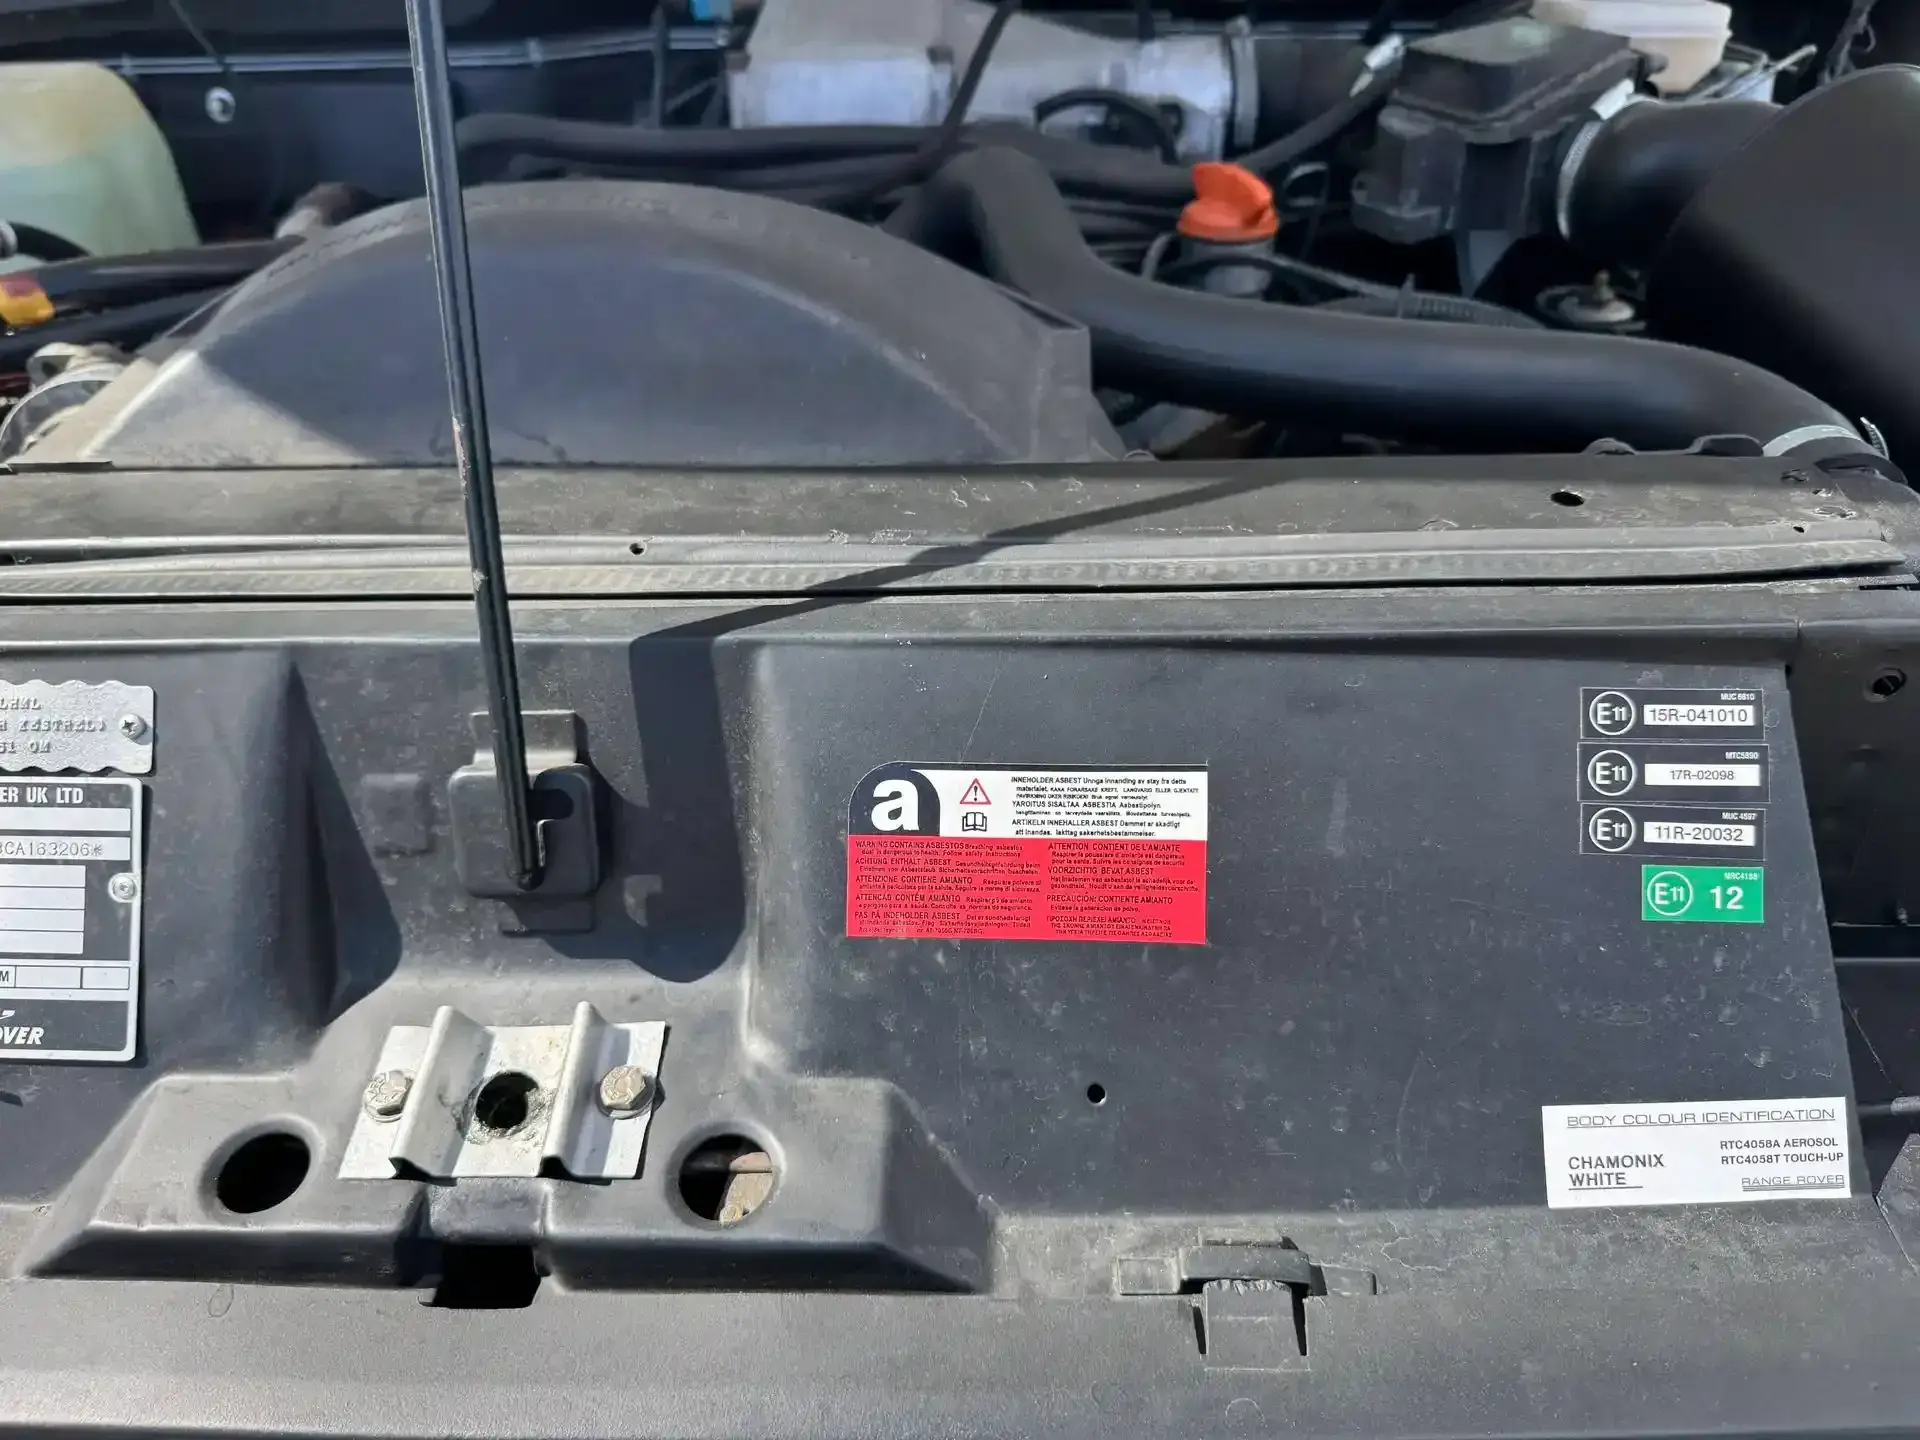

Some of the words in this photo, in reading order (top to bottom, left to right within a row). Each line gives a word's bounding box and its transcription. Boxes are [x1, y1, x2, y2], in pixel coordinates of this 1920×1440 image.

[1649, 708, 1748, 722] 15R-041010
[1670, 769, 1735, 780] 17R-02098
[26, 786, 48, 803] UK
[56, 787, 84, 804] LTD
[871, 779, 920, 831] a
[1655, 826, 1744, 842] 11R-20032
[1048, 842, 1088, 850] ATTENTION
[856, 875, 897, 883] ATTENZIONE
[1710, 885, 1744, 910] 12
[932, 912, 960, 920] ASBEST
[1567, 1115, 1616, 1127] BODY
[1622, 1113, 1697, 1125] COLOUR
[1702, 1109, 1835, 1123] IDENTIFICATION
[1720, 1139, 1780, 1150] RTC4058A
[1784, 1137, 1838, 1148] AEROSOL
[1568, 1153, 1665, 1170] CHAMONIX
[1721, 1154, 1780, 1165] RTC4058T
[1783, 1152, 1844, 1163] TOUCH-UP
[1569, 1172, 1627, 1187] WHITE
[1741, 1176, 1791, 1186] RANGE
[1796, 1174, 1845, 1185] ROVER
